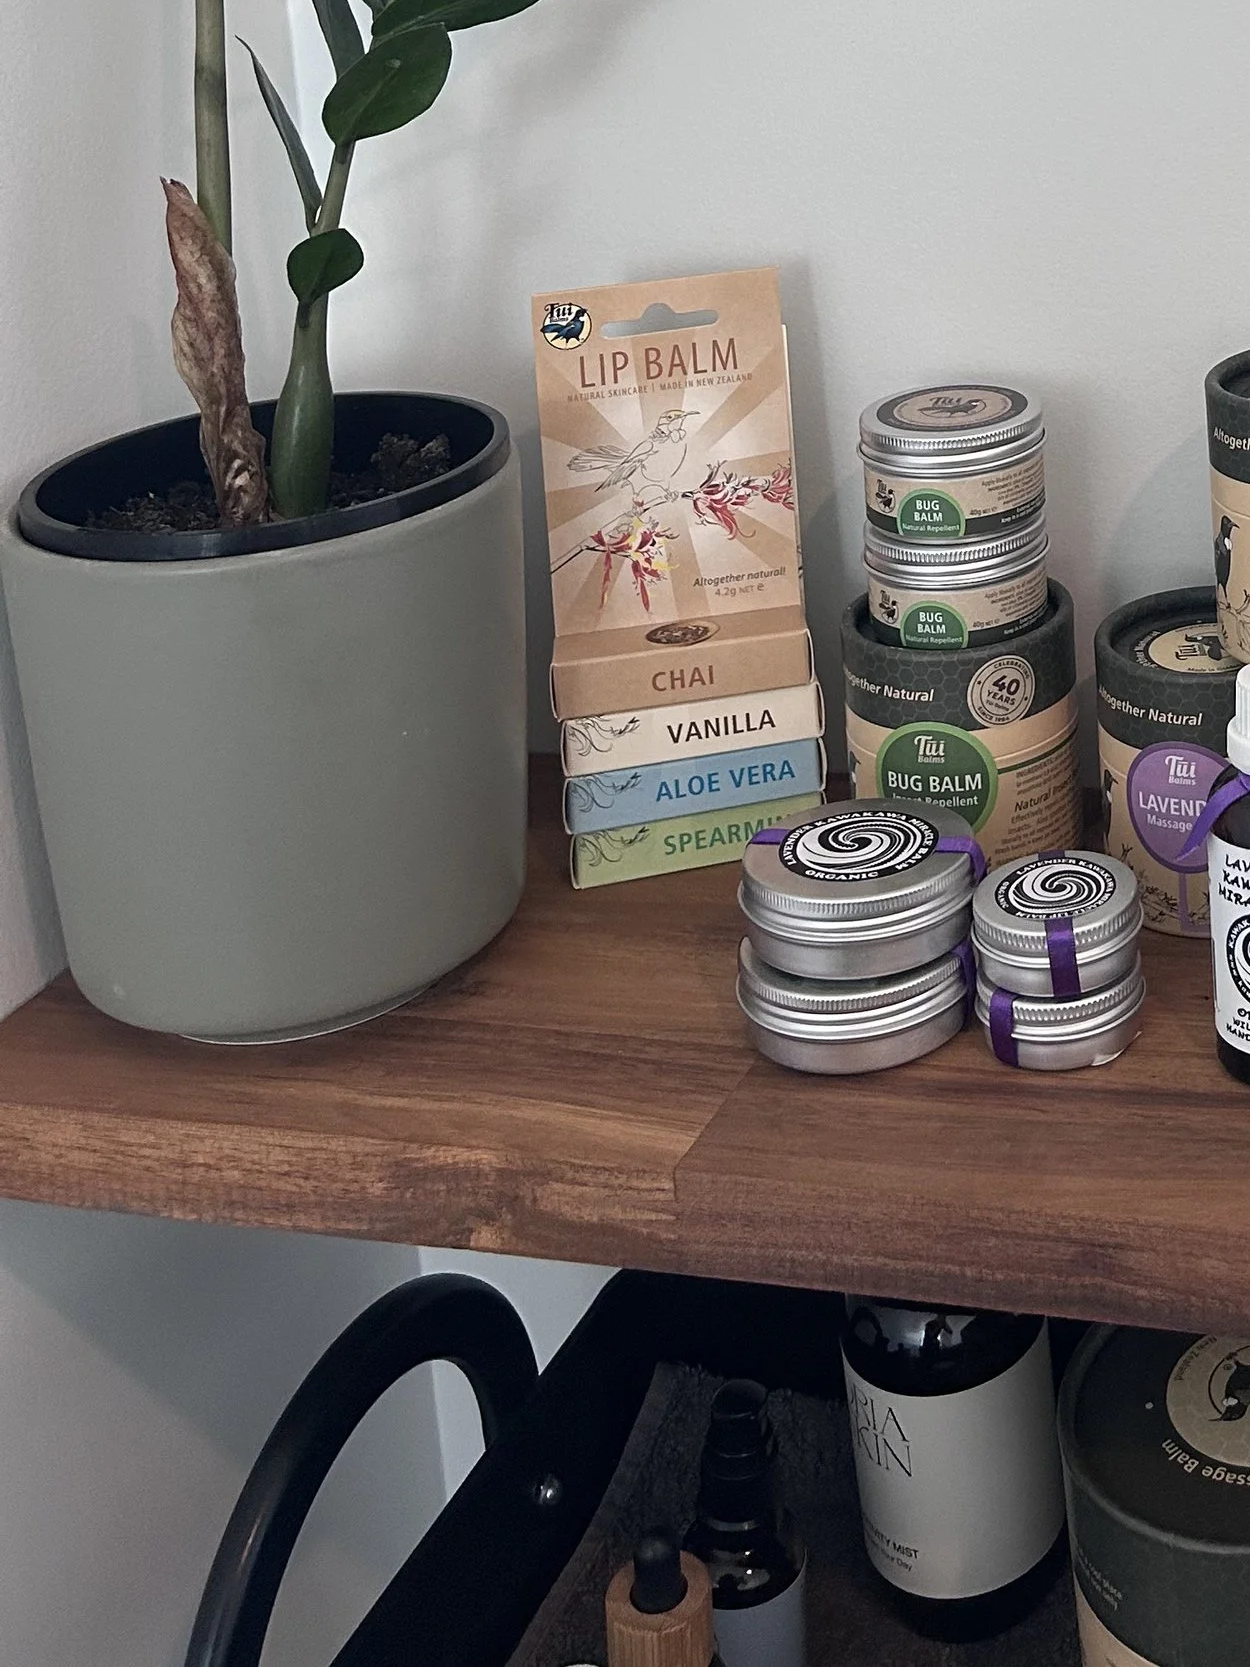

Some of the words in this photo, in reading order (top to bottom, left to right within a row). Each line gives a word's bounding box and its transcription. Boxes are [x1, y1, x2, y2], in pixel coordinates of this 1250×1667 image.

[579, 351, 629, 388] LIP
[645, 338, 739, 380] BALM
[567, 389, 605, 403] NATURAL
[608, 385, 648, 397] SKINCARE
[660, 379, 682, 391] MADE
[696, 376, 714, 386] NEW
[717, 373, 753, 384] ZEALAND
[916, 500, 940, 511] BUG
[914, 511, 943, 522] BALM
[902, 523, 926, 532] Natural
[927, 523, 960, 533] Repellent
[693, 573, 745, 588] Altogether
[747, 566, 787, 581] natural!
[715, 586, 737, 598] 4.2g
[739, 585, 754, 594] NET
[919, 612, 943, 622] BUG
[917, 623, 946, 634] BALM
[905, 634, 929, 643] Natural
[929, 635, 963, 645] Repellent
[652, 665, 714, 692] CHAI
[993, 660, 1031, 680] CELEBRATING
[843, 664, 881, 694] ogether
[883, 685, 934, 702] Natural
[992, 675, 1021, 696] 40
[986, 690, 1017, 707] YEARS
[667, 709, 776, 744] VANILLA
[1148, 708, 1203, 726] Natural
[917, 755, 945, 764] Balms
[656, 772, 721, 802] ALOE
[729, 760, 796, 789] VERA
[887, 771, 922, 791] BUG
[929, 773, 982, 793] BALM
[1168, 775, 1196, 786] Balms
[925, 794, 979, 807] Repellent
[1014, 787, 1052, 812] Natural
[1138, 791, 1207, 817] LAVEND
[1147, 813, 1194, 833] Massage
[664, 814, 791, 856] SPEARM
[783, 824, 813, 865] LAVENDER
[814, 811, 907, 826] KAWAKAWA
[895, 847, 929, 870] BALM
[805, 869, 879, 880] ORGANIC
[1016, 858, 1076, 876] LAVENDER
[856, 1416, 912, 1478] KIN
[1162, 1438, 1199, 1474] Balm
